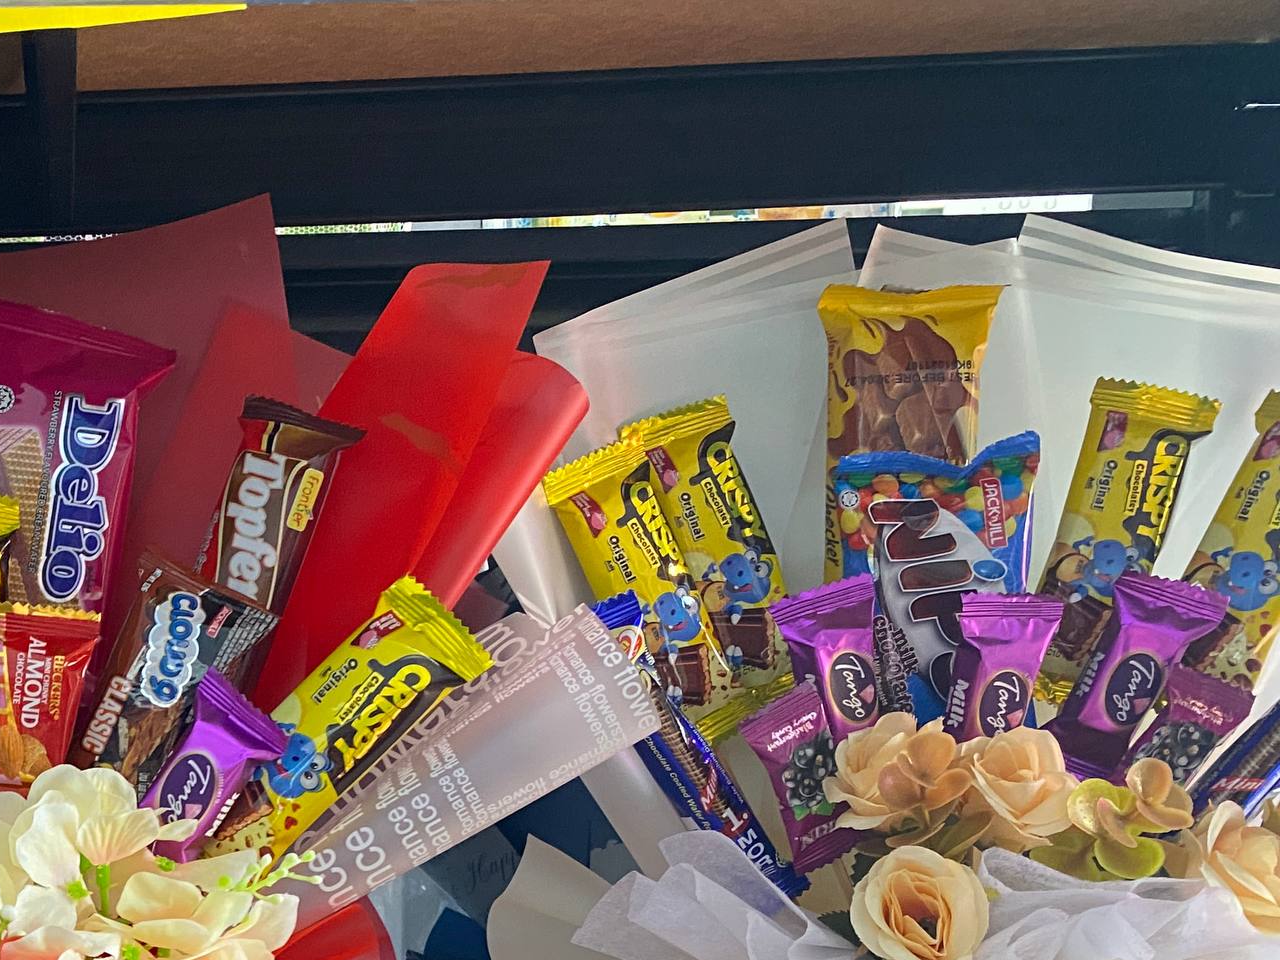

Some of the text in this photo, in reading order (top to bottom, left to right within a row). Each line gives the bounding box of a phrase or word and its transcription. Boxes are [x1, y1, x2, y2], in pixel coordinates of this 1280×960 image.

[45, 389, 63, 452] STRAWBERRY
[40, 396, 125, 600] Delio
[293, 474, 320, 528] Frontier
[679, 491, 705, 540] Original
[1092, 459, 1119, 513] Original
[1238, 470, 1271, 524] Original
[226, 451, 288, 601] Topfer
[607, 535, 635, 583] Original
[13, 651, 26, 705] CHOCOLATE
[888, 622, 920, 676] milk
[20, 636, 48, 730] ALMOND
[49, 655, 66, 718] HECKERS
[149, 674, 178, 701] 9
[313, 657, 359, 703] Original
[614, 664, 656, 730] flowe
[834, 655, 867, 720] Tango
[986, 676, 1021, 735] Tang
[1112, 659, 1156, 723] Tango
[82, 676, 132, 754] CLASSIC
[333, 664, 432, 771] CRISPY
[167, 759, 212, 823] Tango
[669, 770, 689, 799] Coated
